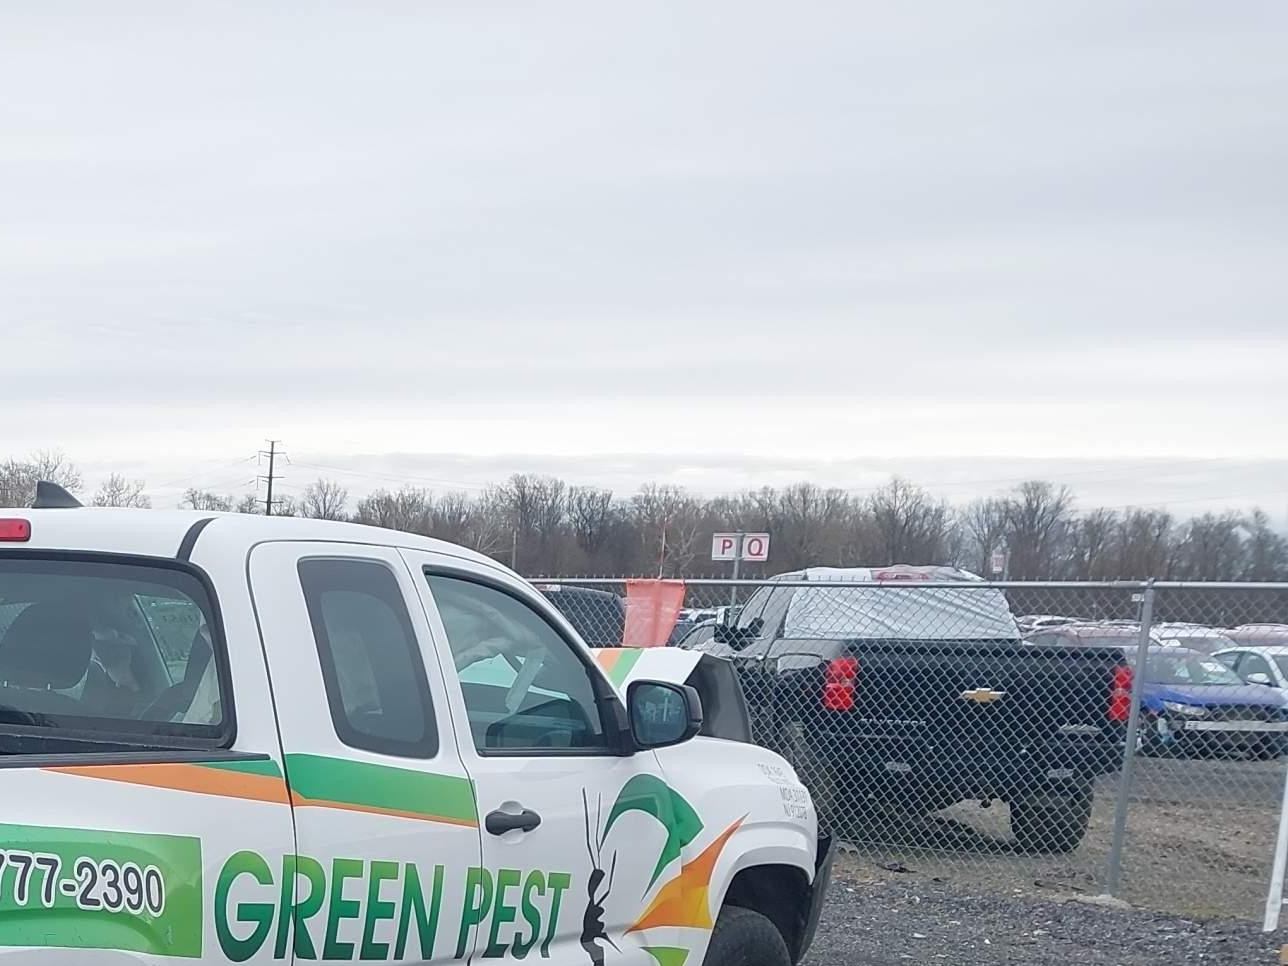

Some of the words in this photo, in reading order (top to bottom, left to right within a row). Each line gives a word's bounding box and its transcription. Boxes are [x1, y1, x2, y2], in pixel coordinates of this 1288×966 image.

[721, 538, 733, 556] P
[747, 538, 764, 557] Q
[214, 850, 445, 963] GREEN
[454, 866, 572, 961] PEST
